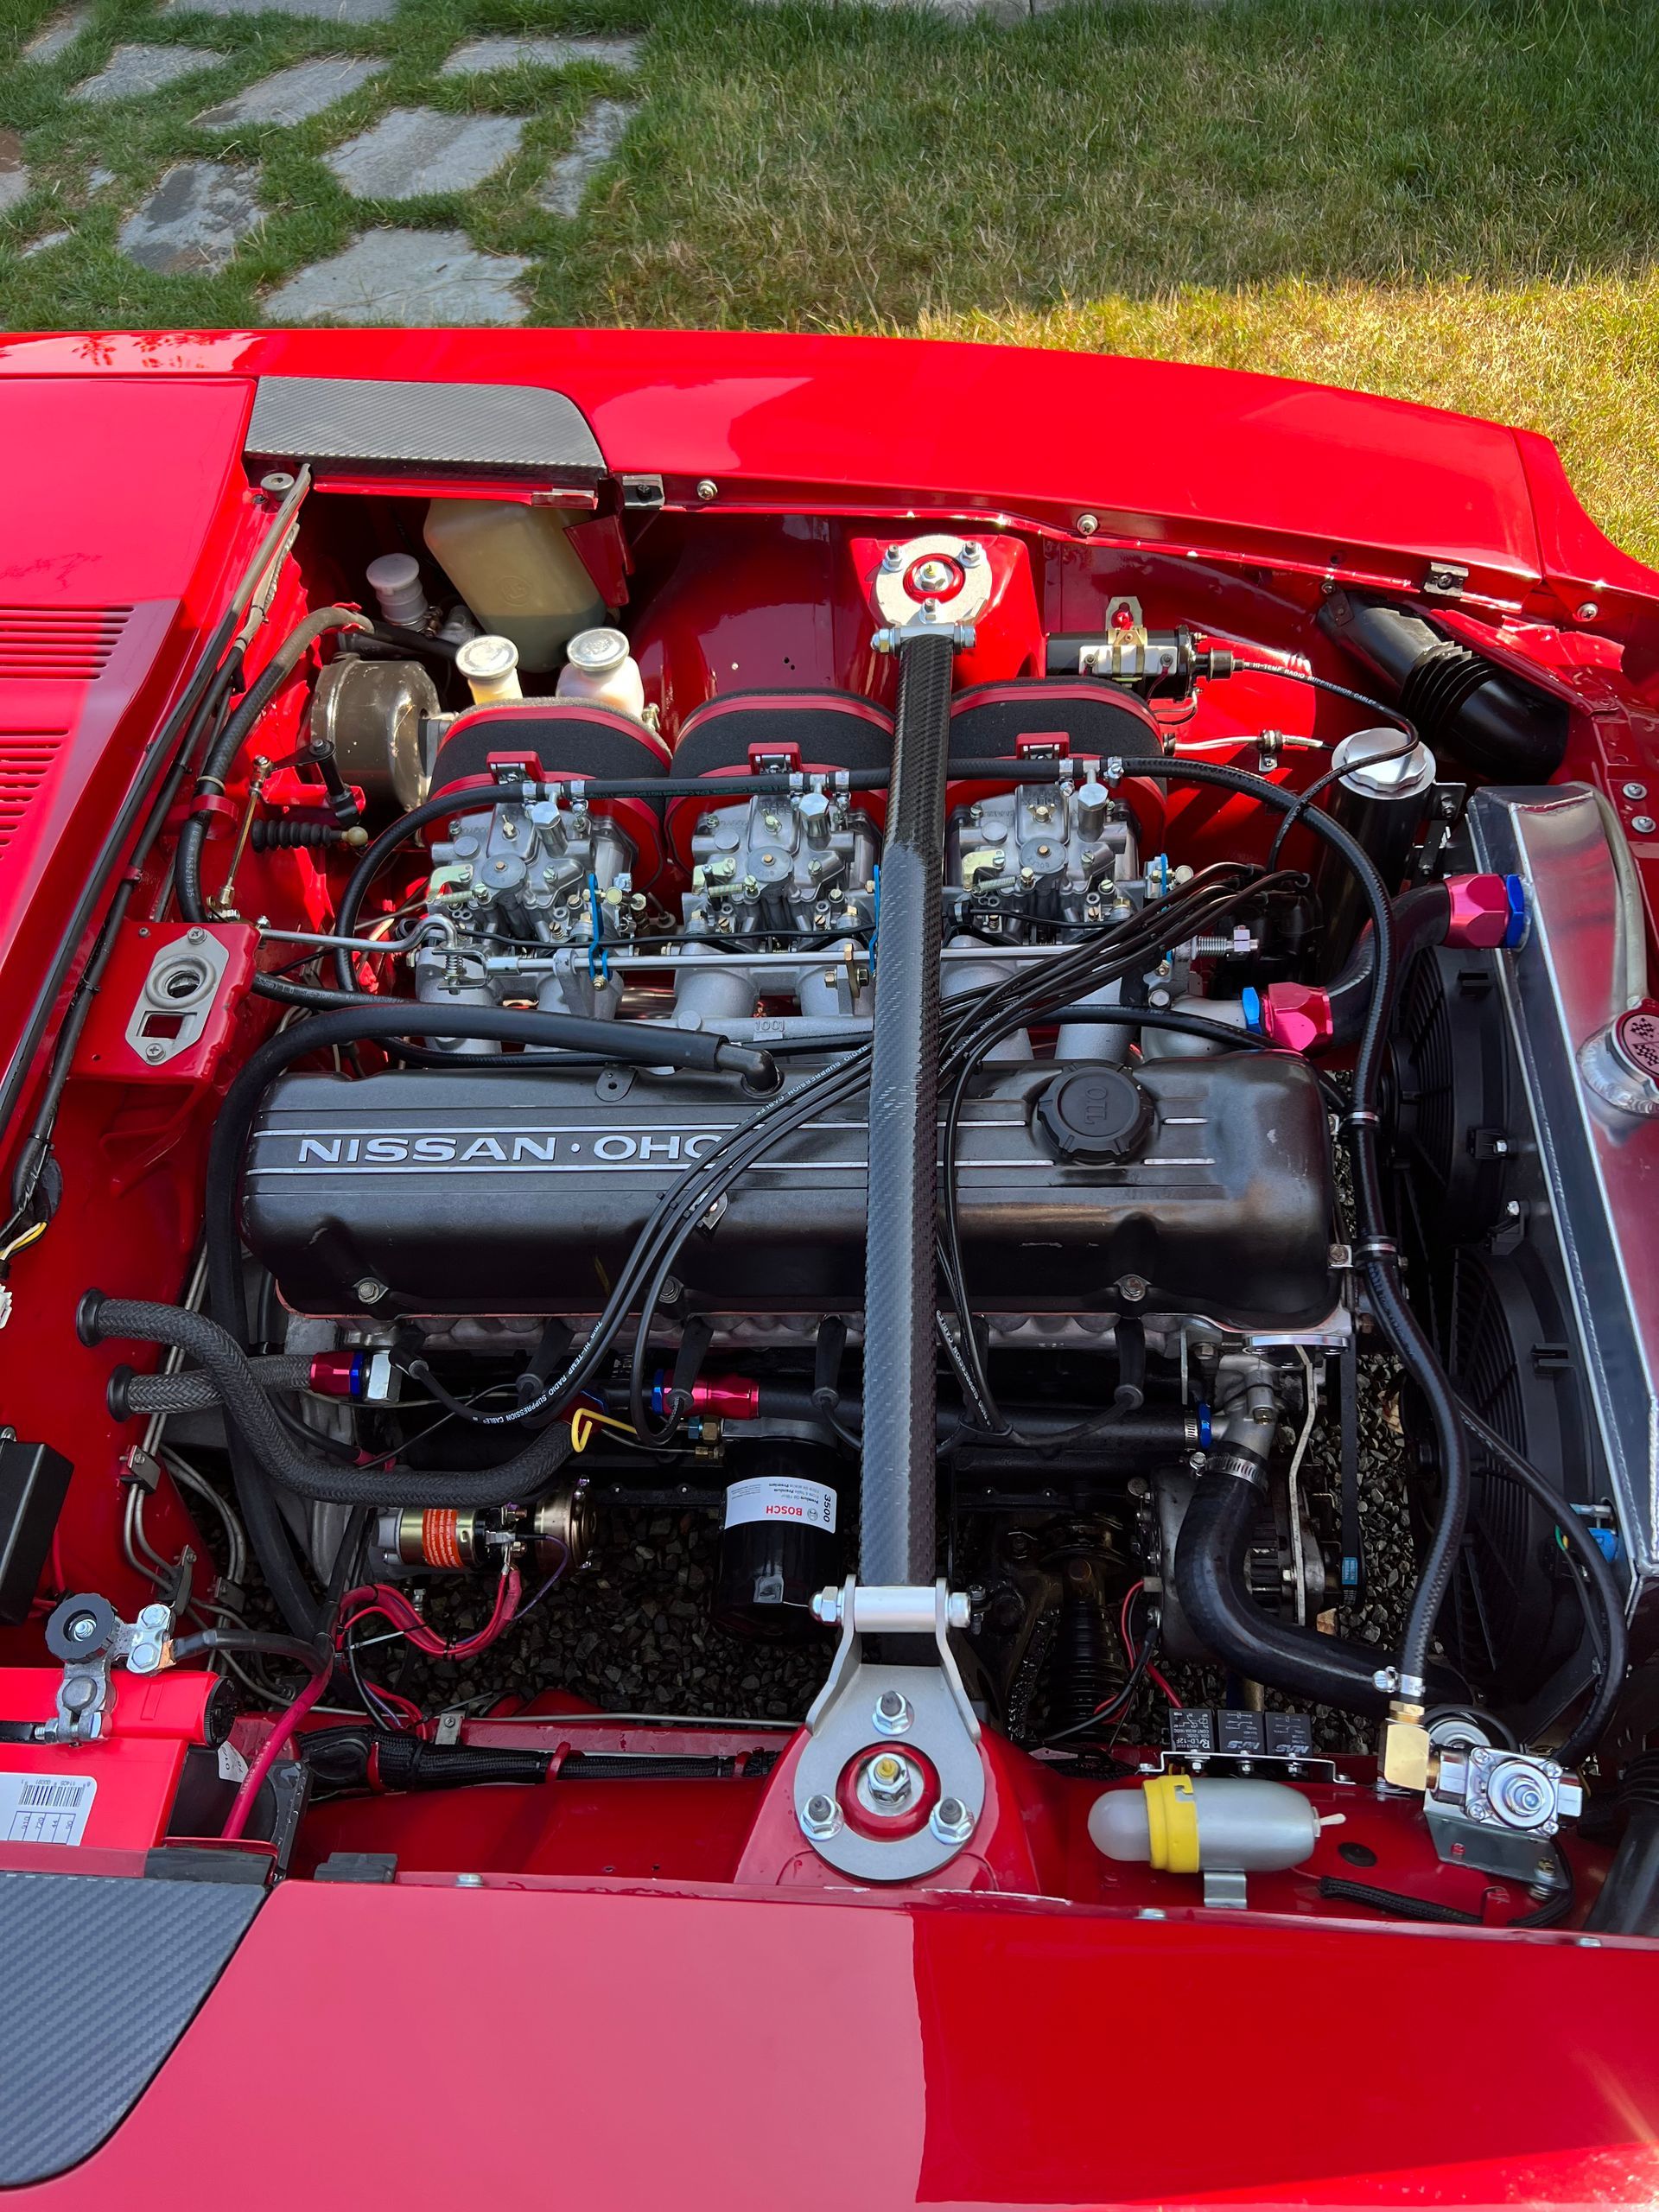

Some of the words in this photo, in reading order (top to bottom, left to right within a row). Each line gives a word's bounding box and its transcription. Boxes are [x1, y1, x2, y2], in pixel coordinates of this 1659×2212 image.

[1085, 1087, 1108, 1125] OIL
[298, 1136, 557, 1163] NISSAN
[590, 1320, 603, 1339] 7mm
[568, 1342, 591, 1375] HI-TEMP
[548, 1375, 568, 1396] RADIO
[505, 1394, 548, 1422] SUPPRESSION
[766, 1505, 803, 1516] BOSCH
[823, 1494, 832, 1522] 3500
